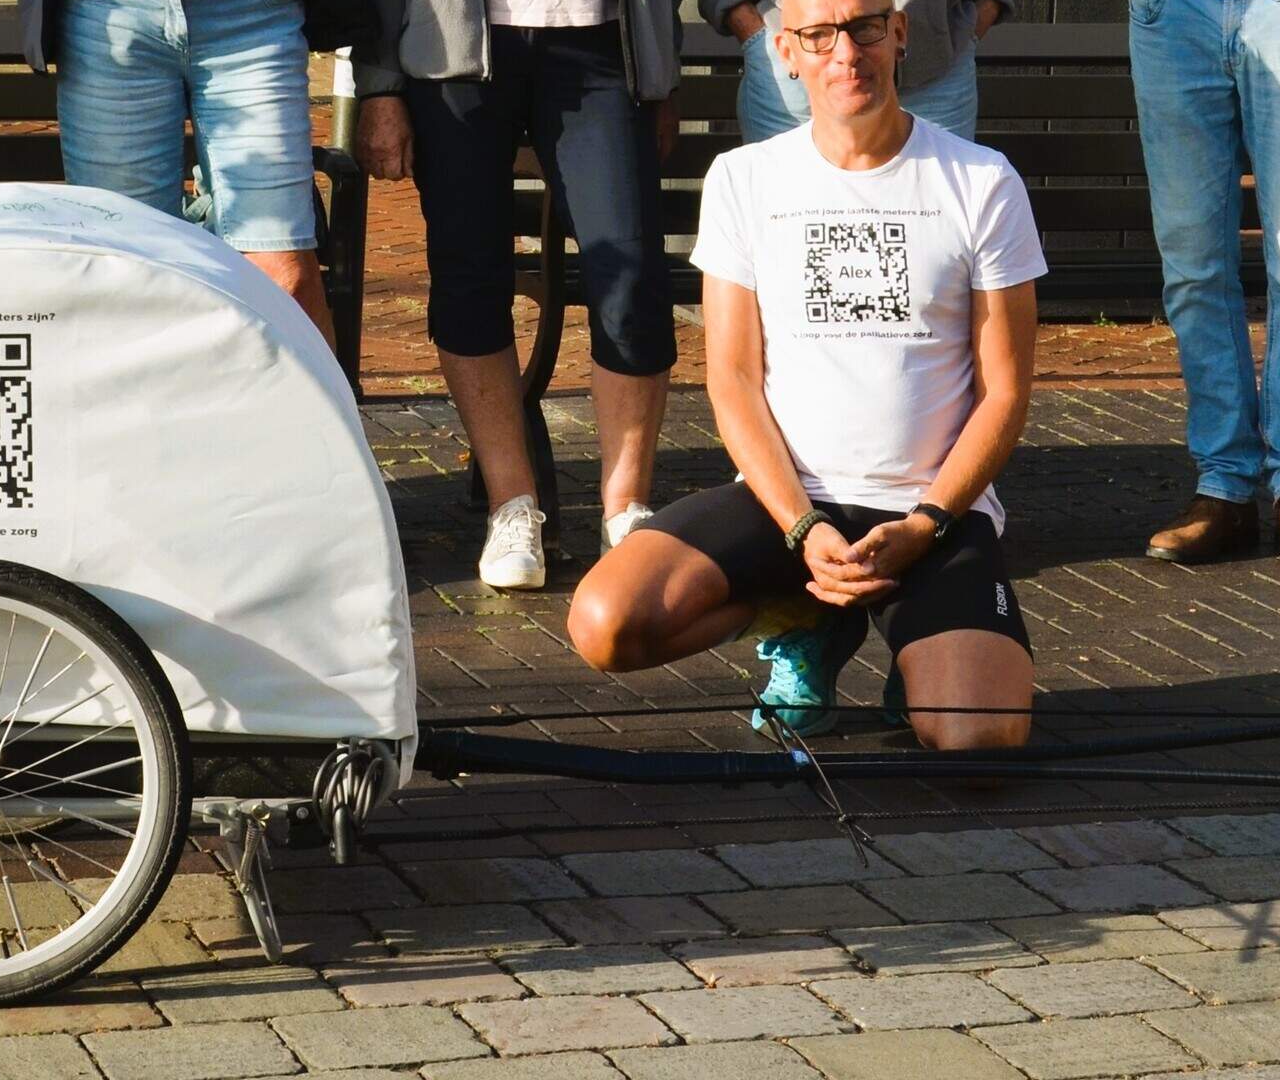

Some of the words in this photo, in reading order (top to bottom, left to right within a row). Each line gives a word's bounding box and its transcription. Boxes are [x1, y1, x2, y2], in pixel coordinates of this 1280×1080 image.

[822, 208, 844, 216] jouw
[839, 266, 872, 279] Alex
[27, 313, 56, 323] zijn?
[10, 528, 38, 538] zorg
